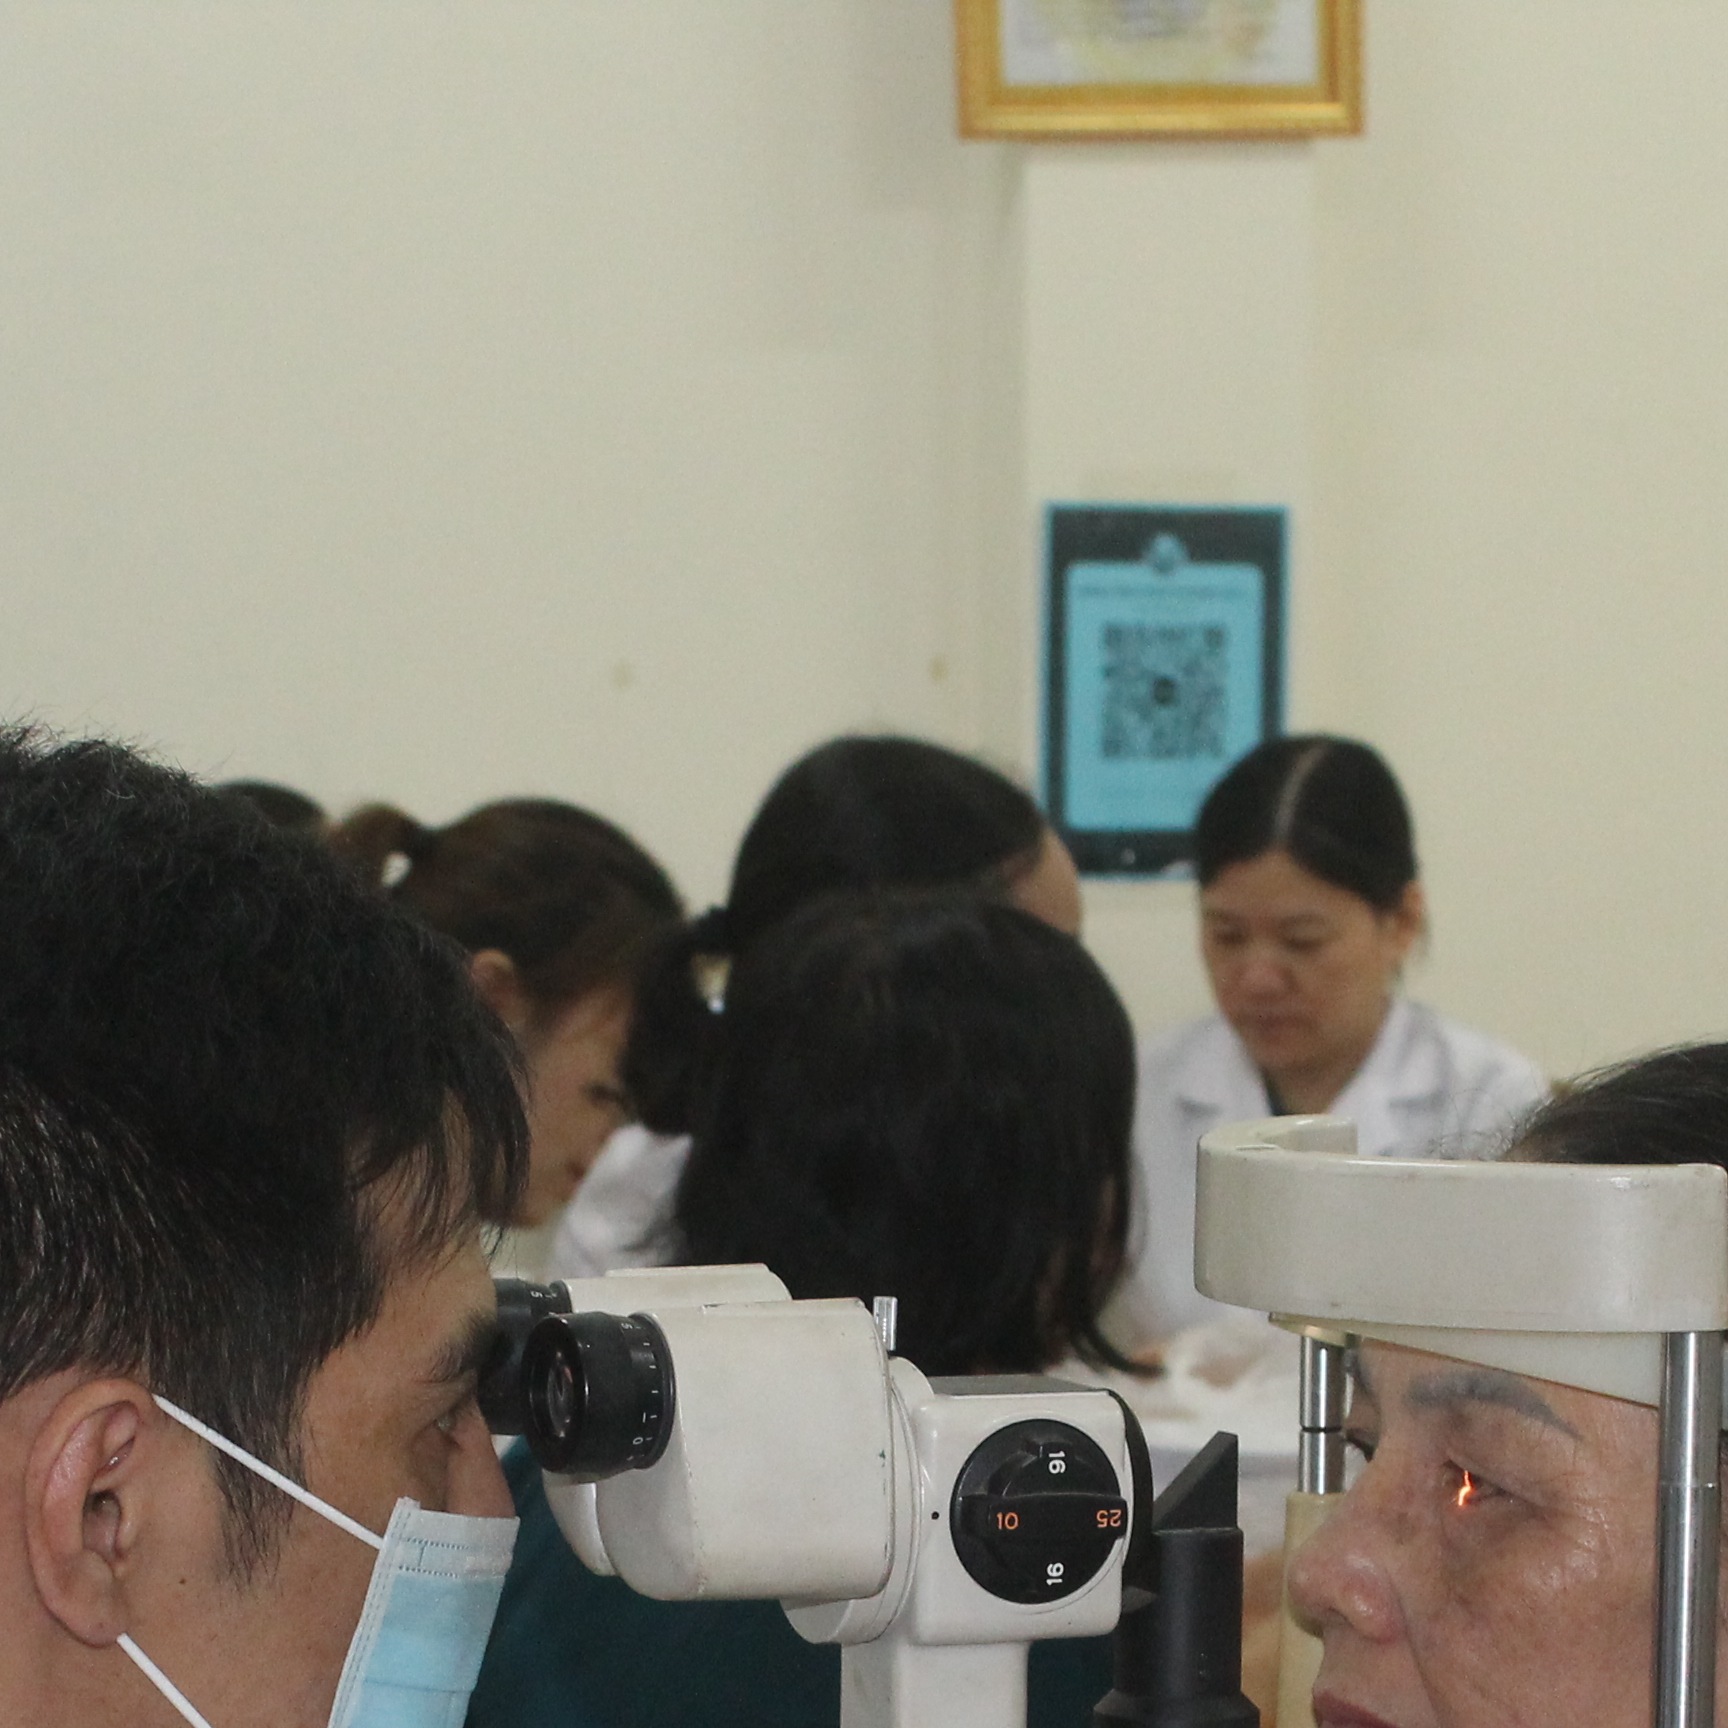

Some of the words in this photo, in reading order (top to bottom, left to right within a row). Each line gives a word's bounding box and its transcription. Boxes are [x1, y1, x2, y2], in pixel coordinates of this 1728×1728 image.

[1048, 1450, 1066, 1474] 16
[996, 1511, 1019, 1530] 10
[1096, 1509, 1122, 1528] 25
[1046, 1562, 1065, 1586] 16
